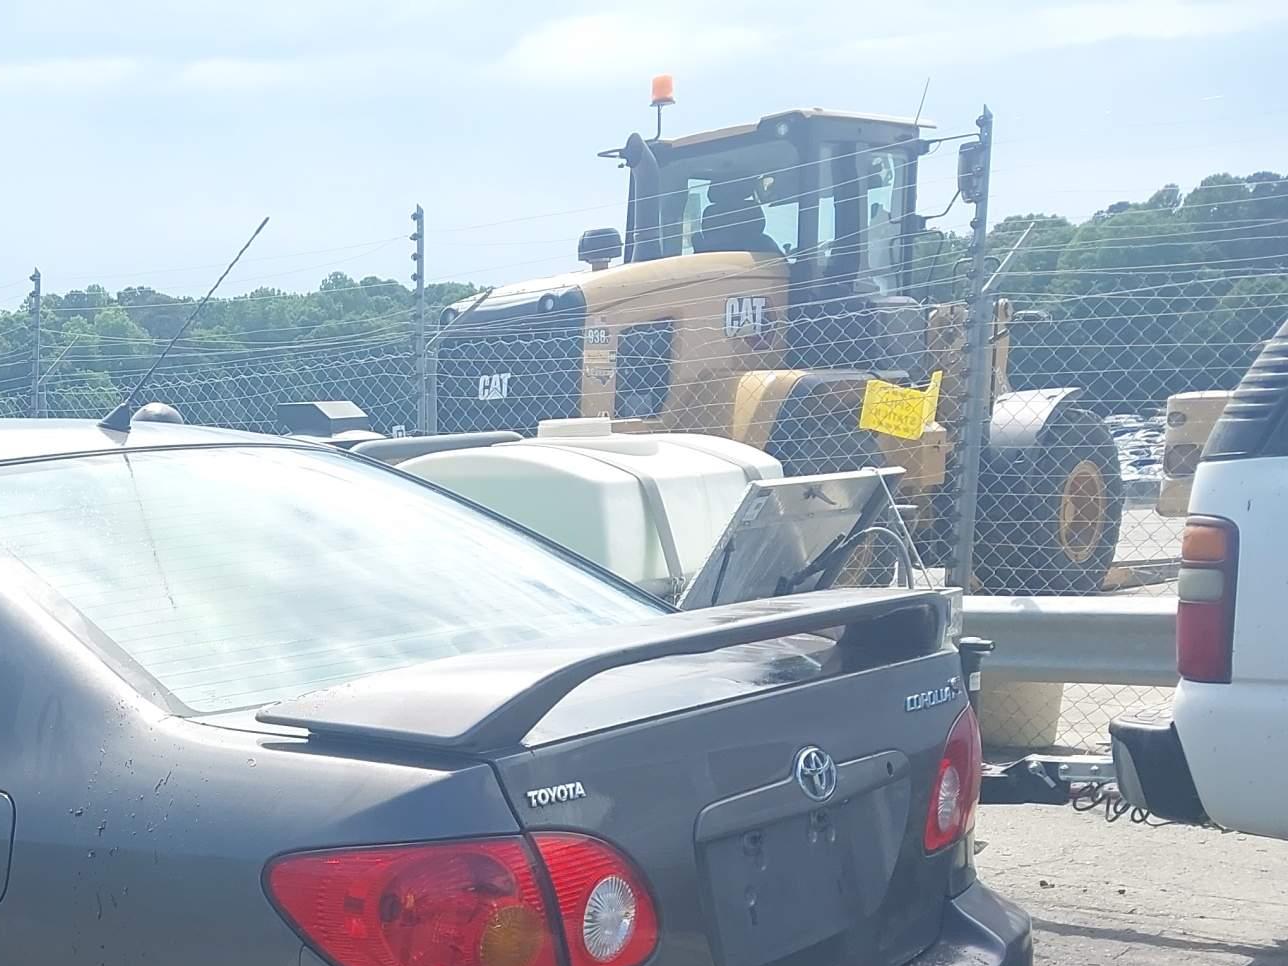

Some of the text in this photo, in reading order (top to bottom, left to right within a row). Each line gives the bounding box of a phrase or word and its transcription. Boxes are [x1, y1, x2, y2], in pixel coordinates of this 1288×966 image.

[725, 297, 766, 337] CAT
[478, 372, 512, 401] CAT
[905, 686, 952, 712] COROLLA
[526, 781, 587, 807] TOYOTA
